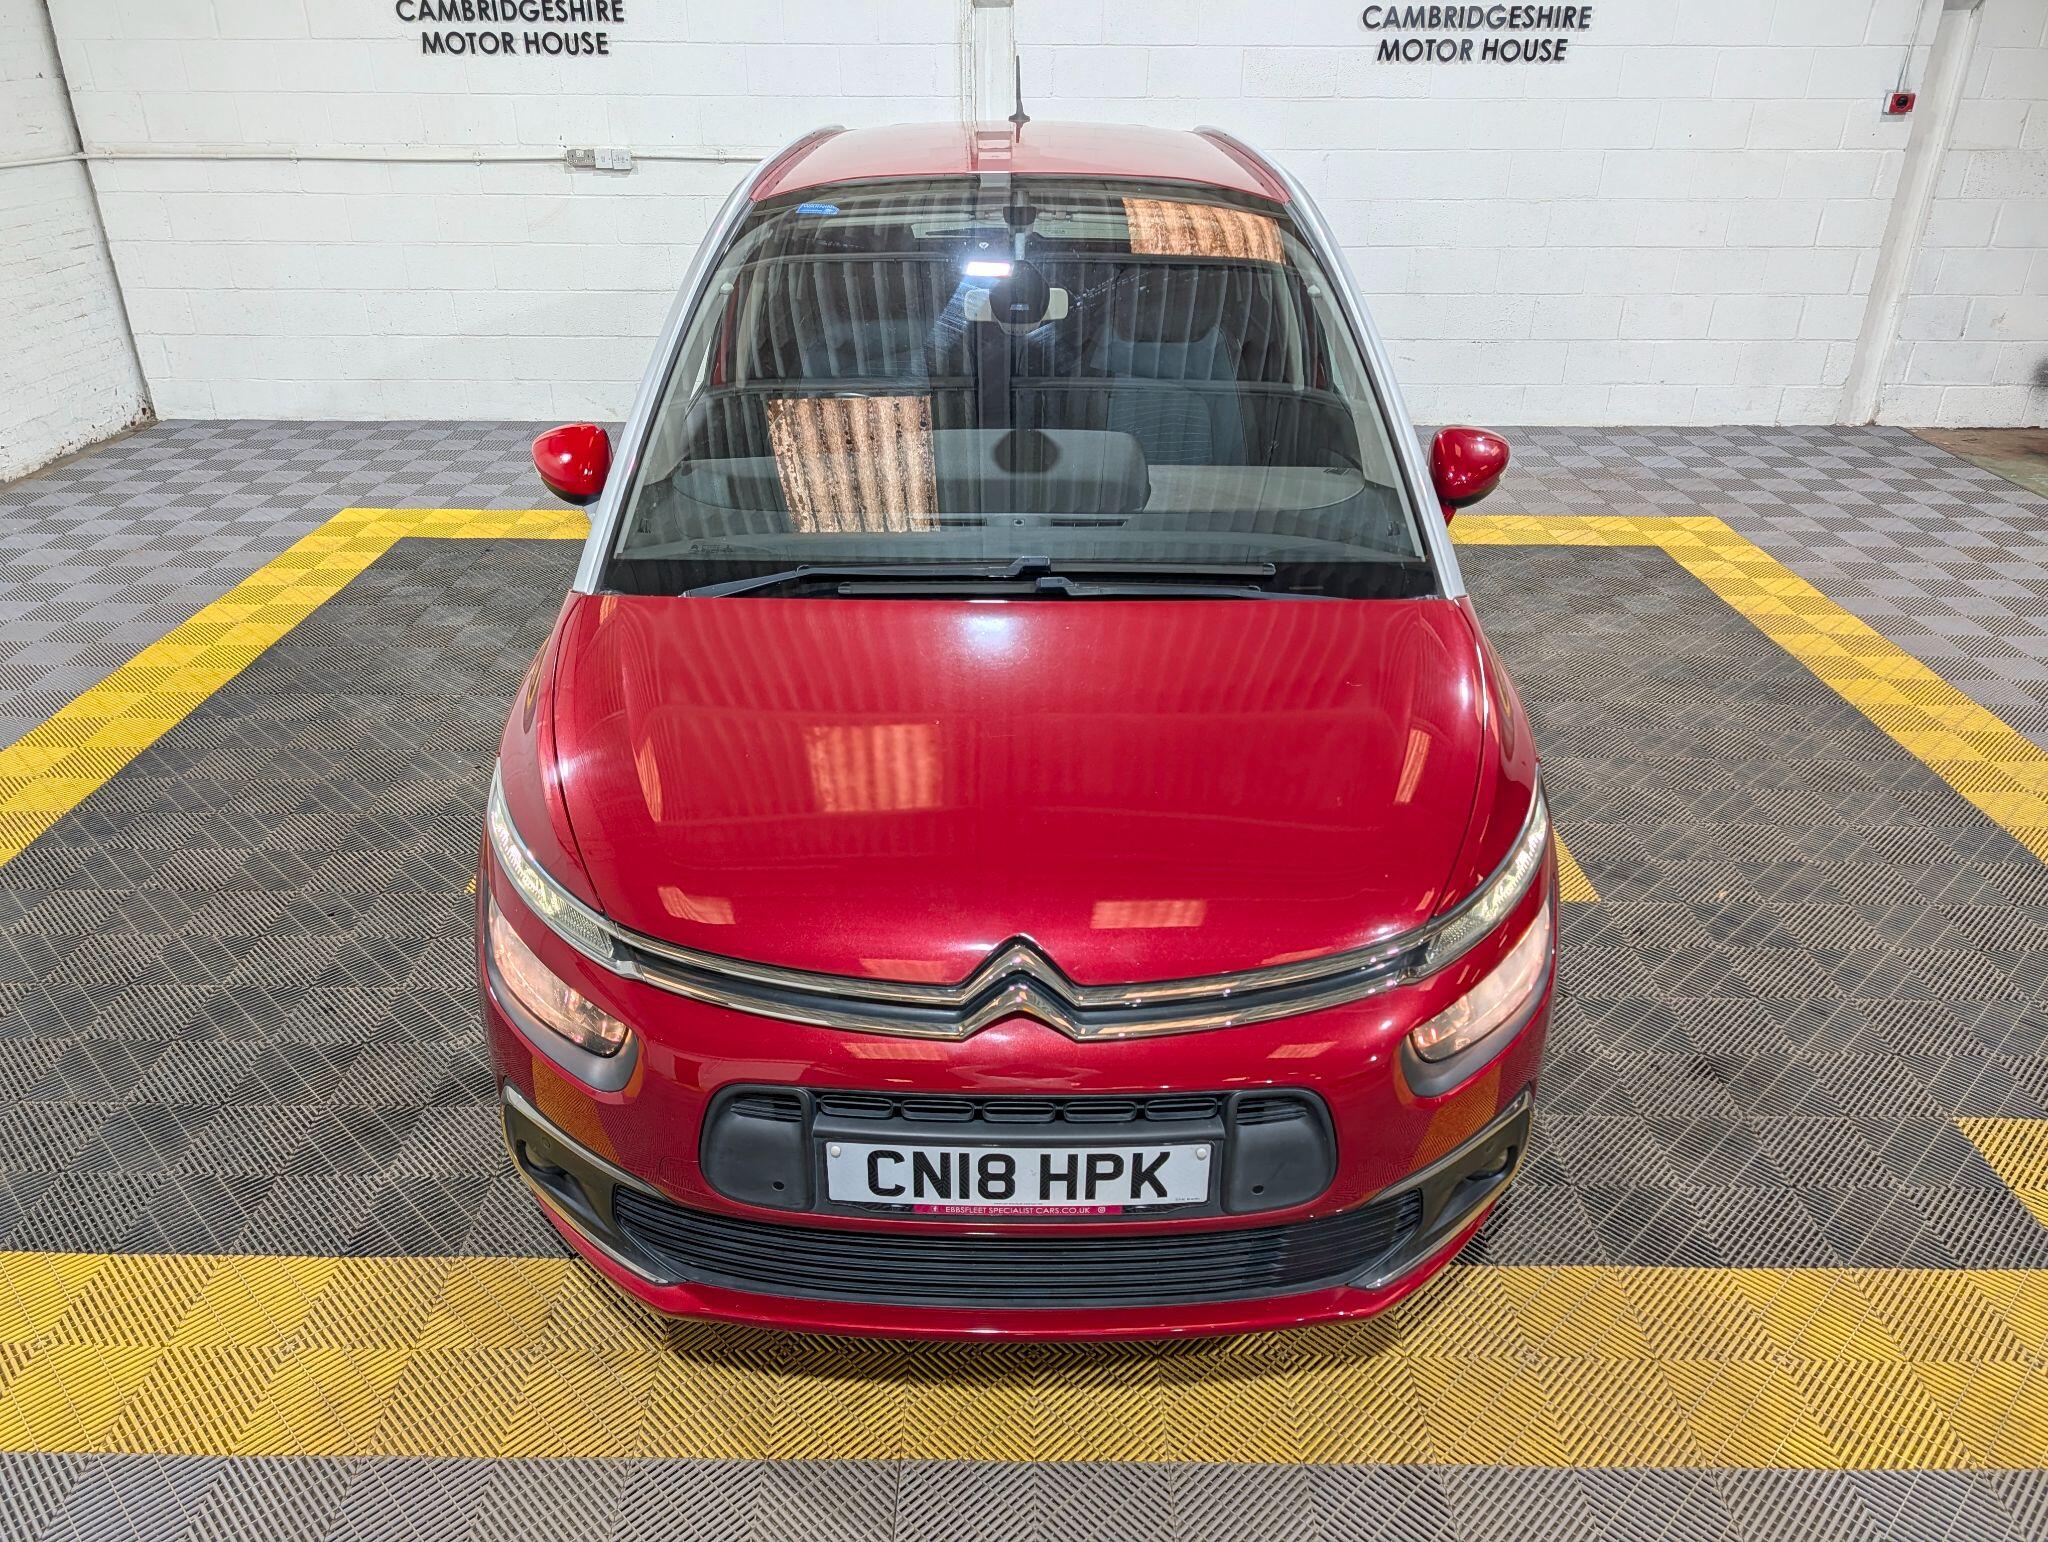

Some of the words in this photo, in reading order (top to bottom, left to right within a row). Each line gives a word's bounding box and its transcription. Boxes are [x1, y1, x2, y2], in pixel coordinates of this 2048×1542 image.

[396, 0, 625, 22] CAMBRIDGESHIRE
[1362, 4, 1593, 29] CAMBRIDGESHIRE
[422, 31, 516, 55] MOTOR
[524, 32, 609, 55] HOUSE
[1377, 38, 1474, 62] MOTOR
[1481, 38, 1568, 63] HOUSE
[867, 1149, 1016, 1200] CN18
[1039, 1151, 1171, 1200] HPK
[945, 1206, 987, 1214] EBBSFLEET
